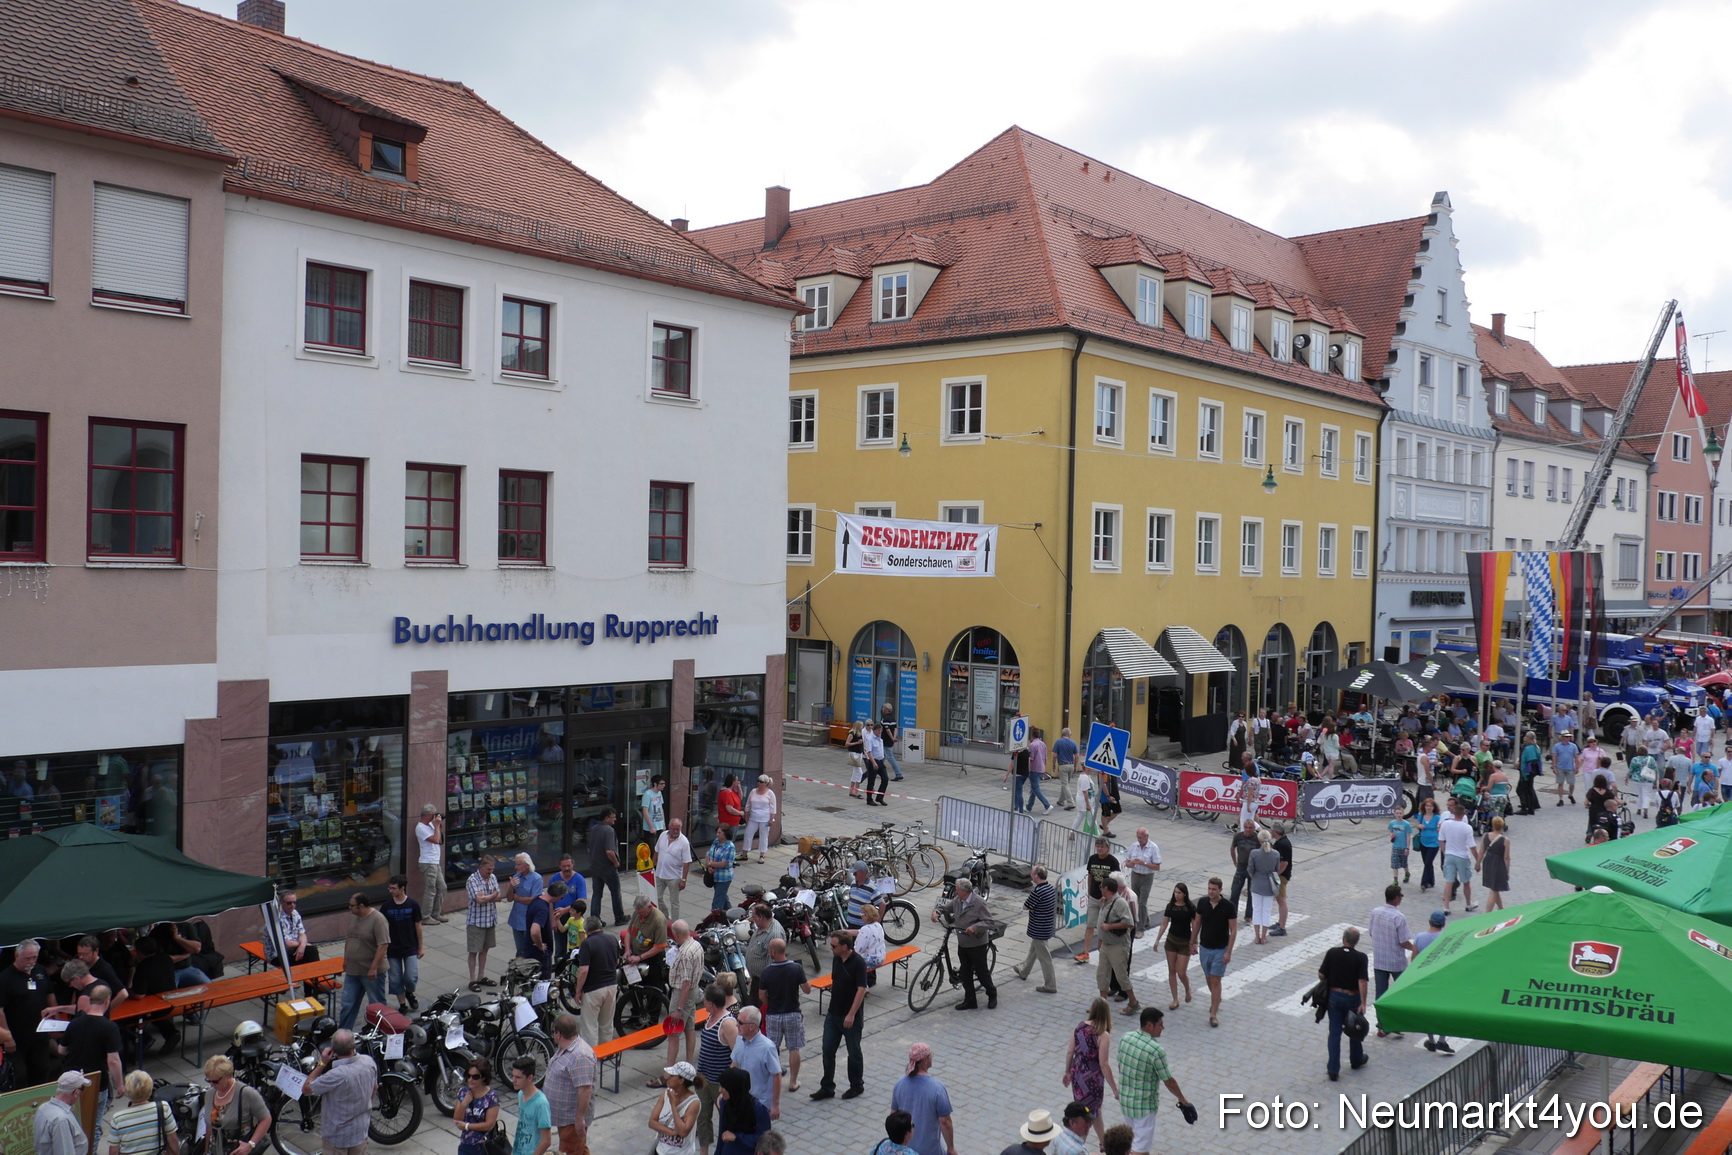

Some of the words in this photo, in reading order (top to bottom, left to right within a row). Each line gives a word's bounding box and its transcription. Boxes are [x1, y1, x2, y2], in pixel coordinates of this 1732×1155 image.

[861, 526, 978, 550] RESIDENZPLATZ
[887, 554, 953, 568] Sonderschauen
[393, 613, 595, 645] Buchhandlung
[604, 612, 719, 644] Rupprecht
[1131, 771, 1158, 787] Dietz
[1341, 793, 1379, 804] Dietz
[1597, 859, 1667, 888] Lammsbräu
[1620, 855, 1673, 875] Neumarkter
[1580, 967, 1604, 975] 1628
[1528, 978, 1655, 1003] Neumarkter
[1501, 989, 1675, 1025] Lammsbräu
